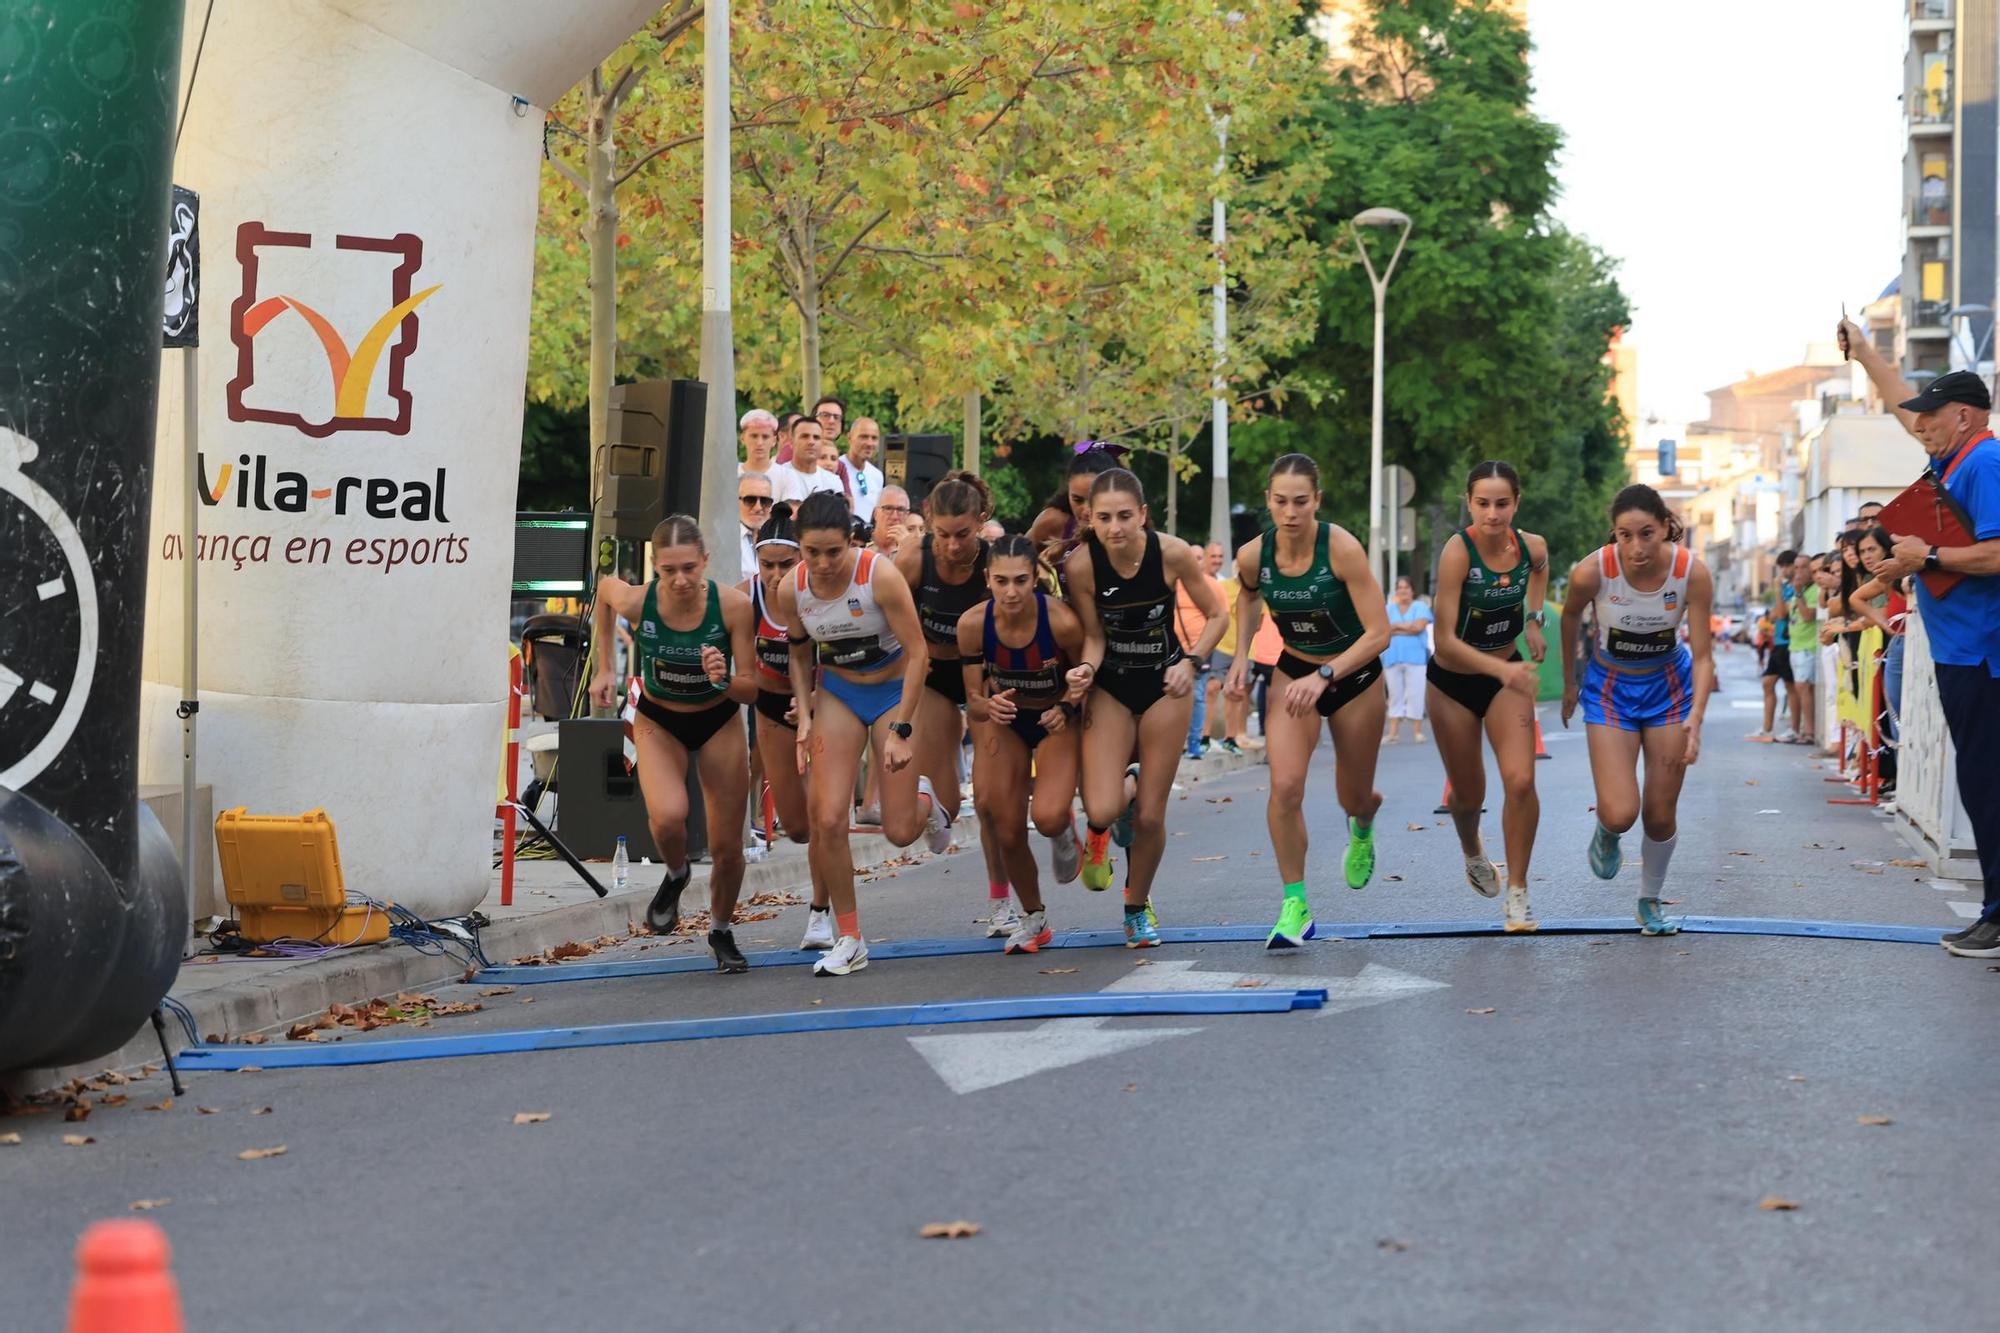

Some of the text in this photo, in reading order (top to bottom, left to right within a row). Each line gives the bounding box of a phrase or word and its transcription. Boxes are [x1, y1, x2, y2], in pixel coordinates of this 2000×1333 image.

[285, 536, 331, 564] en
[345, 532, 470, 574] esports
[1273, 590, 1312, 600] Facsa
[1485, 620, 1510, 635] SOTO
[659, 645, 700, 656] Facsa
[1616, 641, 1669, 653] GONZÁLEZ
